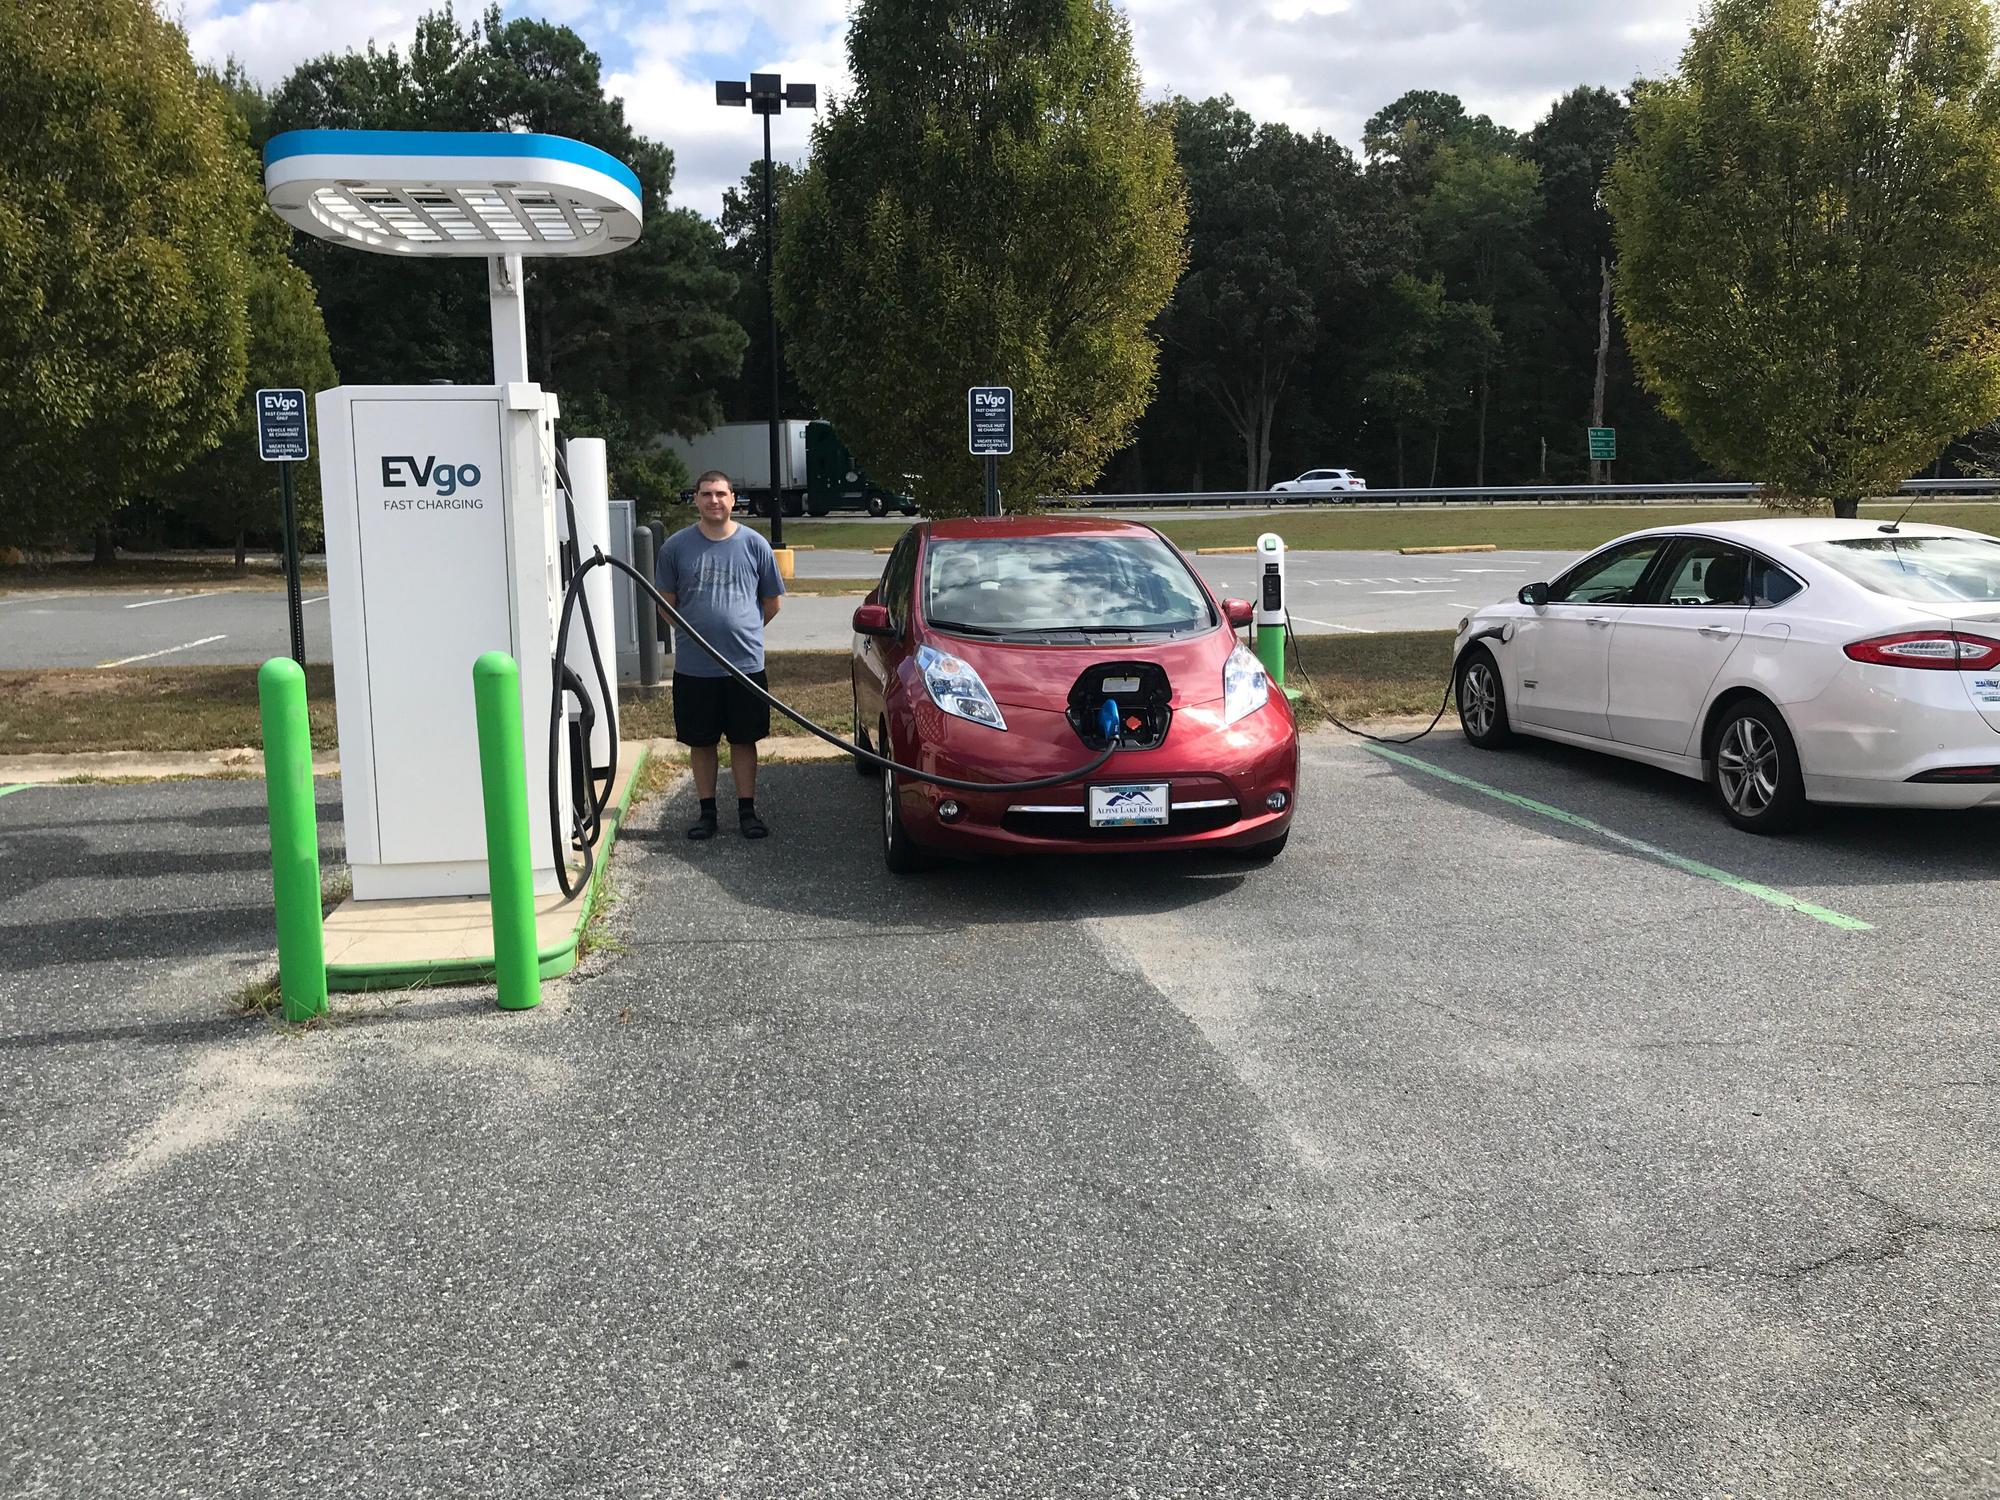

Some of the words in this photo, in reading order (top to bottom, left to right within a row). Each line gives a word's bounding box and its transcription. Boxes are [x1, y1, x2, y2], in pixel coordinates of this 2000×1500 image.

[264, 396, 298, 411] EVgo
[976, 394, 1005, 408] EVgo
[381, 455, 482, 496] EVgo
[384, 500, 413, 510] FAST
[417, 499, 483, 510] CHARGING
[1096, 806, 1119, 814] ALPINE
[1120, 805, 1137, 814] LAKE
[1139, 805, 1163, 815] RESORT
